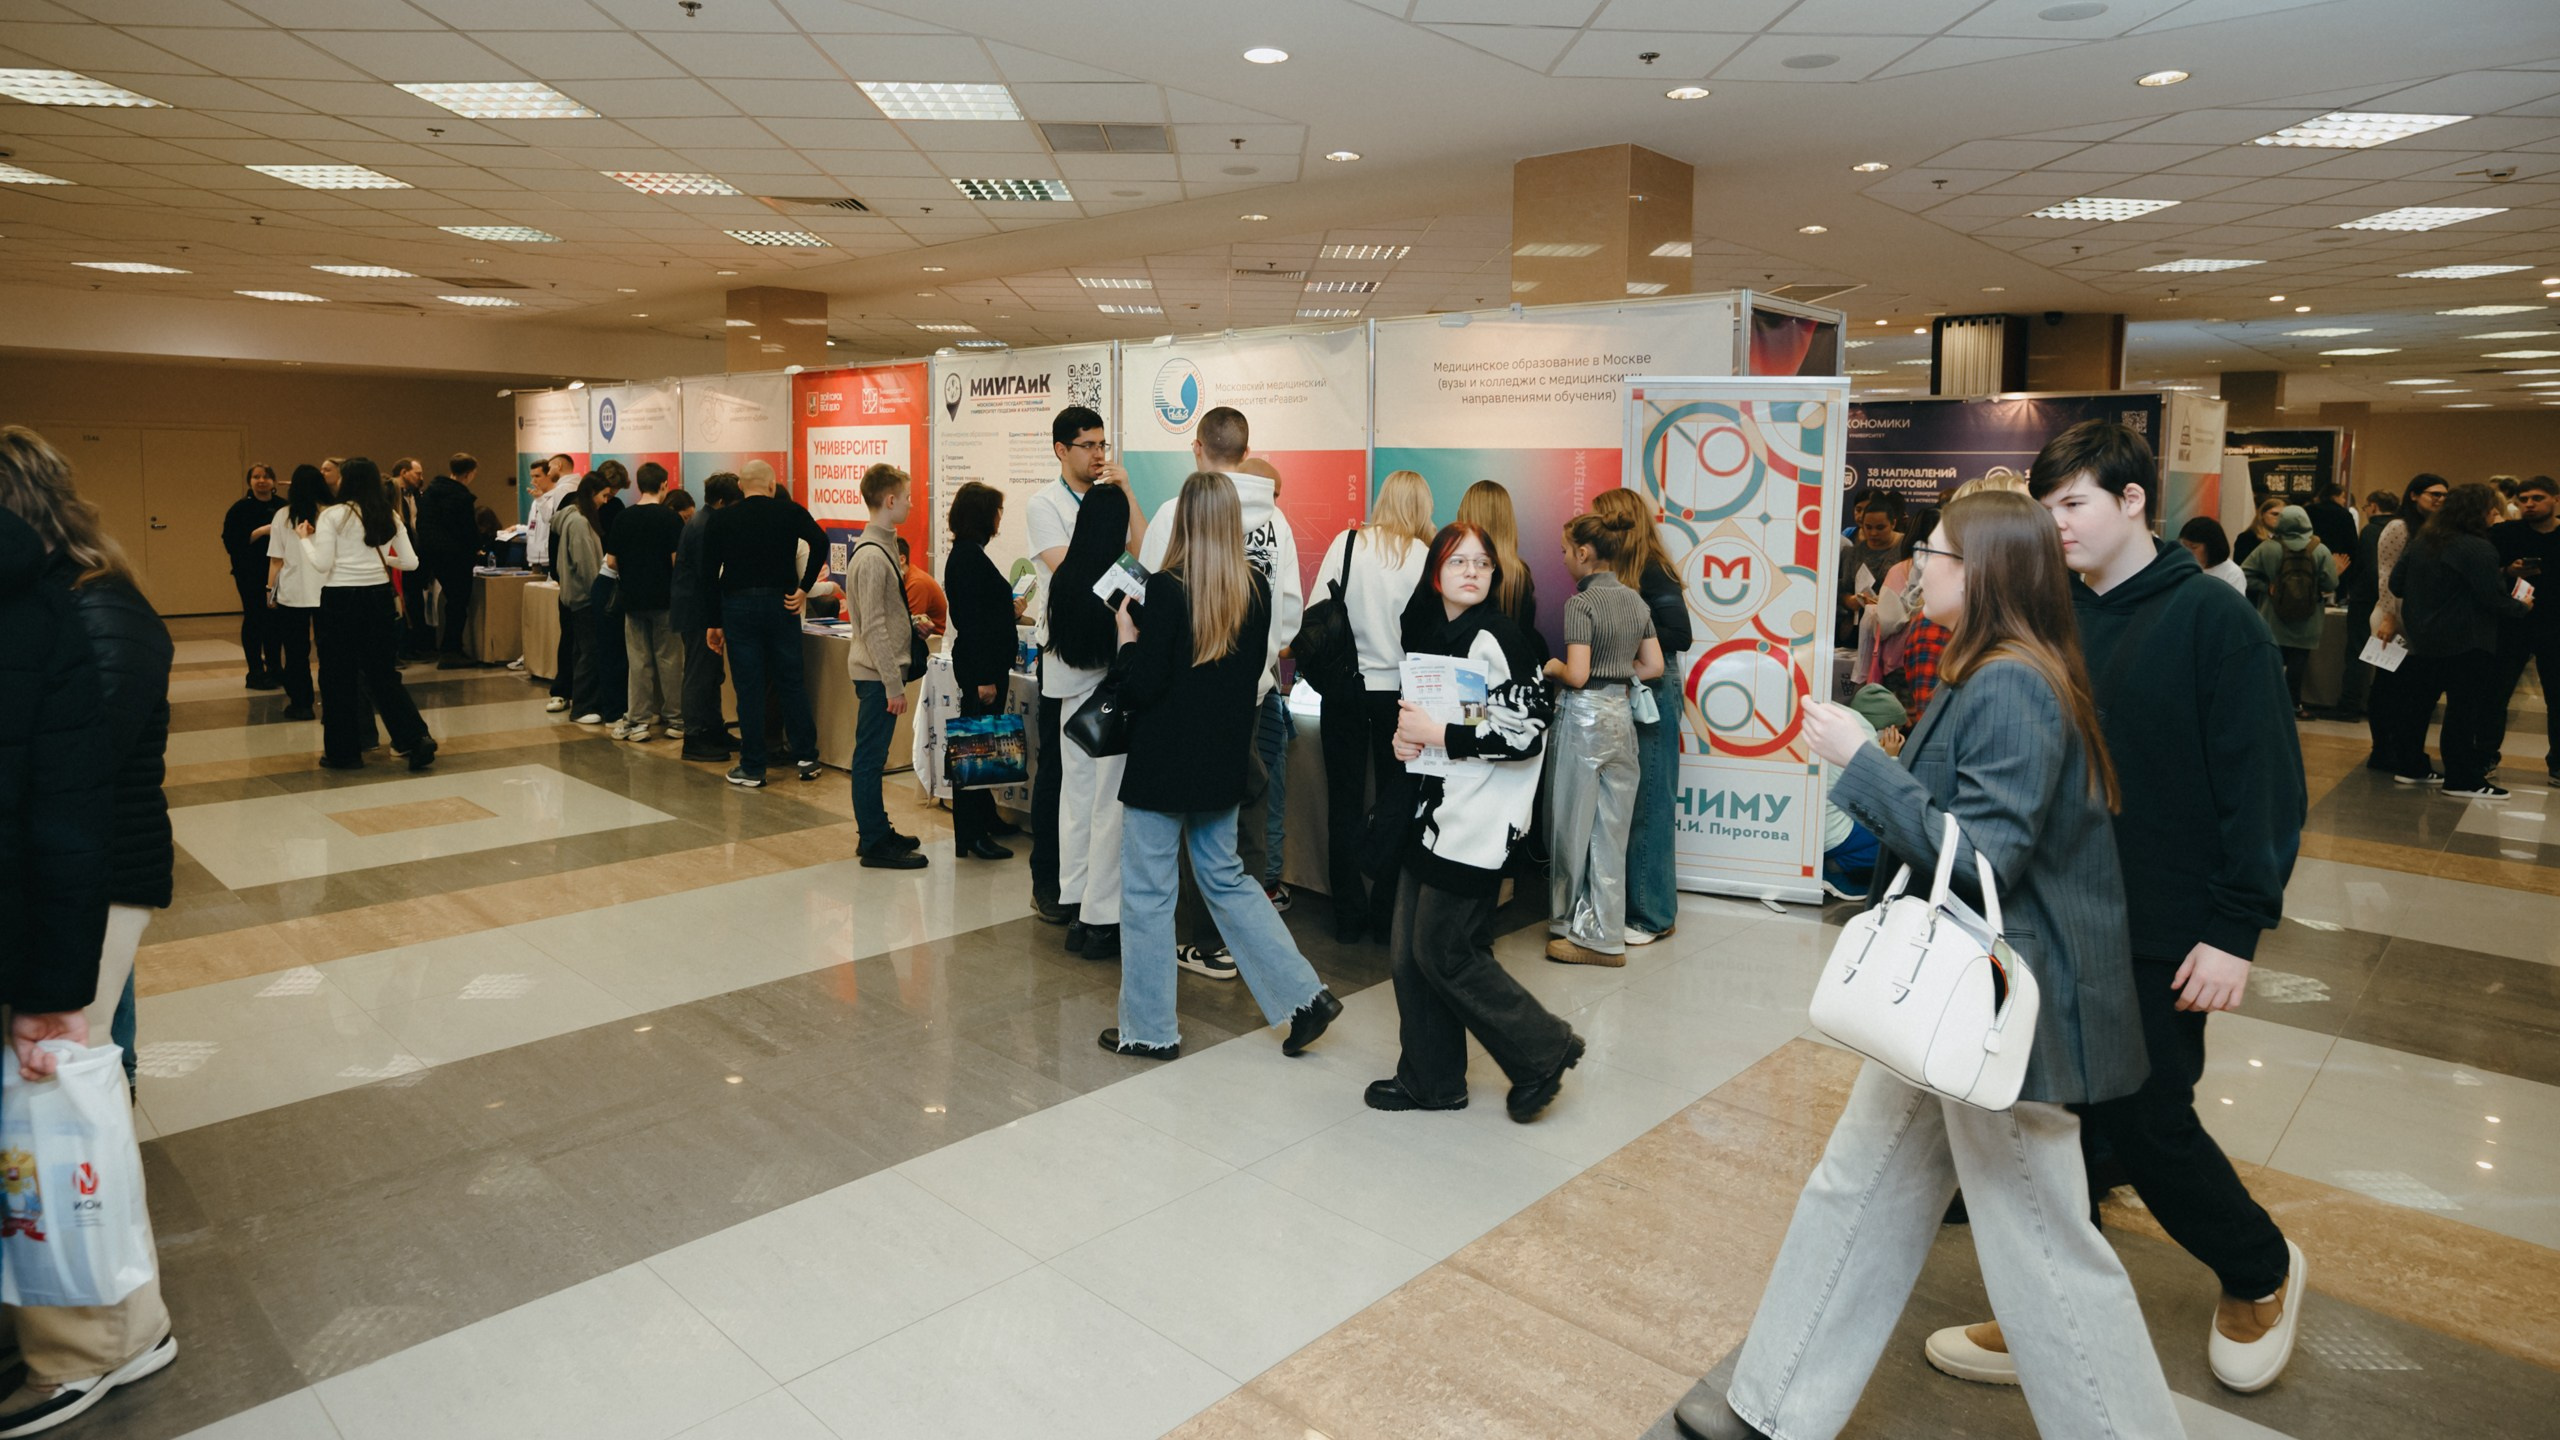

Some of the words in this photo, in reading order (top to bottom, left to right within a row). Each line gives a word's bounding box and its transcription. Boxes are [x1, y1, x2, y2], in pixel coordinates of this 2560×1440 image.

[1433, 361, 1509, 373] Медицинское
[1511, 358, 1590, 371] образование
[1592, 357, 1600, 366] в
[1603, 353, 1651, 365] Москве
[970, 373, 1051, 397] МИИГАиК
[1215, 381, 1264, 392] Московский
[1267, 378, 1327, 390] медицинский
[1438, 378, 1467, 390] (вузы
[1470, 379, 1477, 387] и
[1479, 376, 1536, 388] колледжи
[1539, 377, 1546, 385] с
[1549, 372, 1642, 386] медицински
[1215, 396, 1267, 406] университет
[1462, 393, 1551, 405] направлениями
[1554, 389, 1617, 403] обучения)
[1847, 418, 1910, 429] КОНОМИКИ
[814, 440, 888, 455] УНИВЕРСИТЕТ
[2224, 446, 2253, 455] ервый
[1867, 468, 1879, 477] 38
[1881, 466, 1957, 479] НАПРАВЛЕНИЙ
[1347, 474, 1357, 501] ВУЗ
[1573, 450, 1586, 517] ОЛЛЕДЖ
[1866, 478, 1937, 489] ПОДГОТОВКИ
[814, 489, 862, 504] МОСКВЫ
[1676, 787, 1792, 823] НИМУ
[1709, 822, 1790, 841] Пирогова
